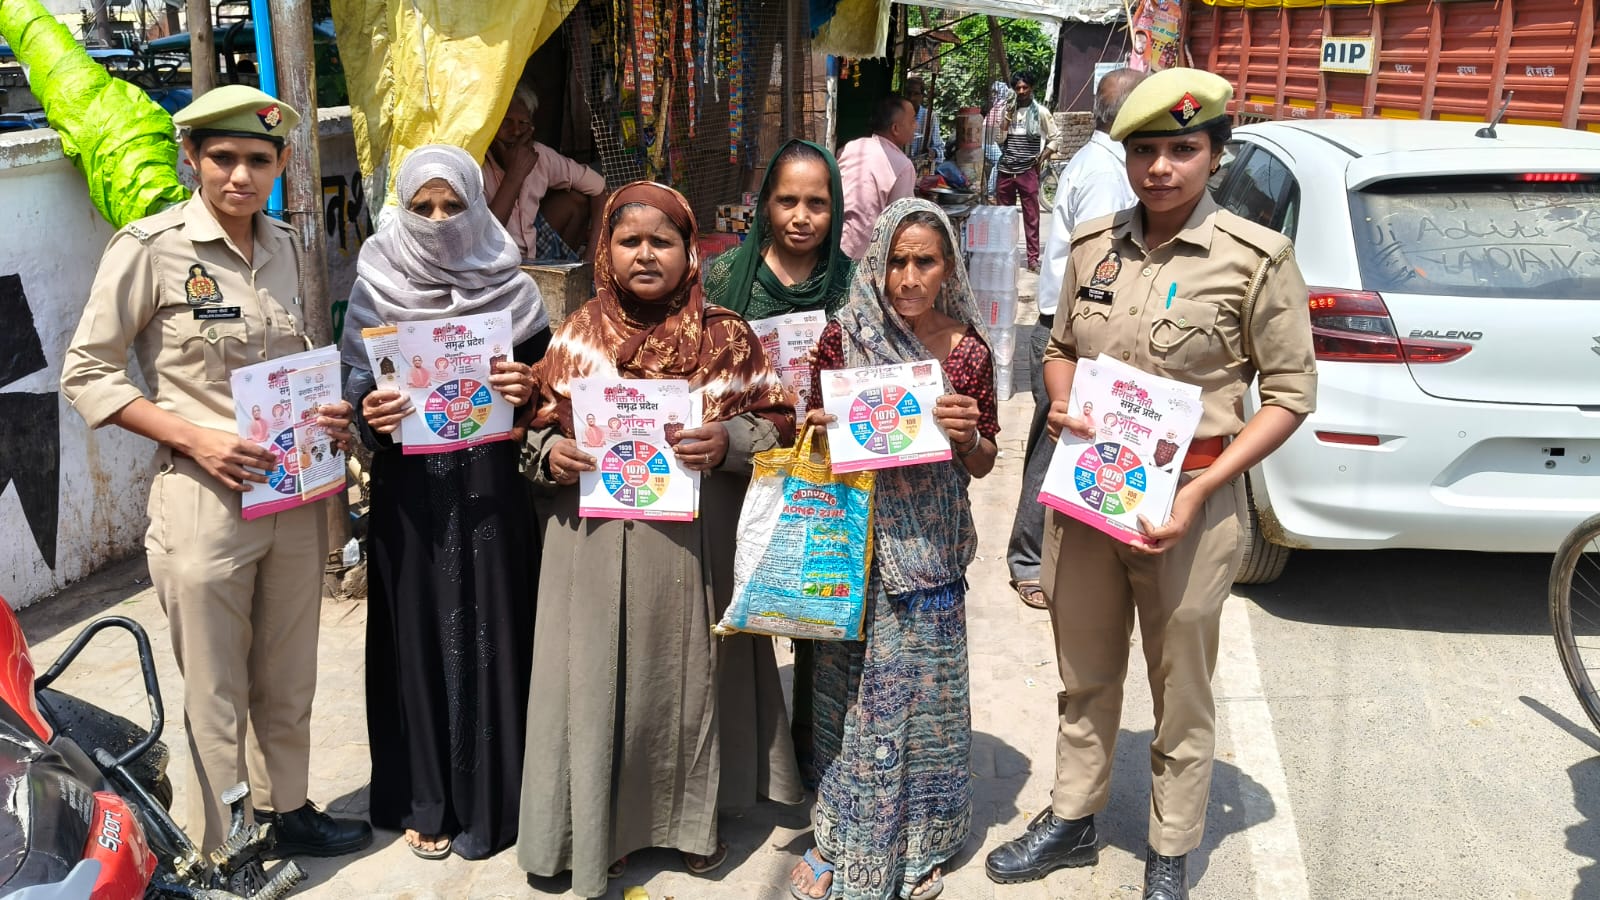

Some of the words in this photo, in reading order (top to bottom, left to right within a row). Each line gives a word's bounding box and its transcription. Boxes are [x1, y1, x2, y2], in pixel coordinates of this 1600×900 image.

[1323, 43, 1366, 63] AIP
[1409, 329, 1483, 340] BALENO
[444, 341, 465, 352] समृद्ध
[467, 337, 485, 347] प्रदेश
[450, 401, 470, 411] 1076
[616, 402, 638, 413] समृद्ध
[639, 401, 658, 410] प्रदेश
[1120, 399, 1142, 413] समृद्ध
[1142, 408, 1162, 421] प्रदेश
[873, 410, 896, 421] 1076
[626, 465, 646, 475] 1076
[1102, 467, 1122, 483] 1076
[97, 809, 124, 853] Sport
